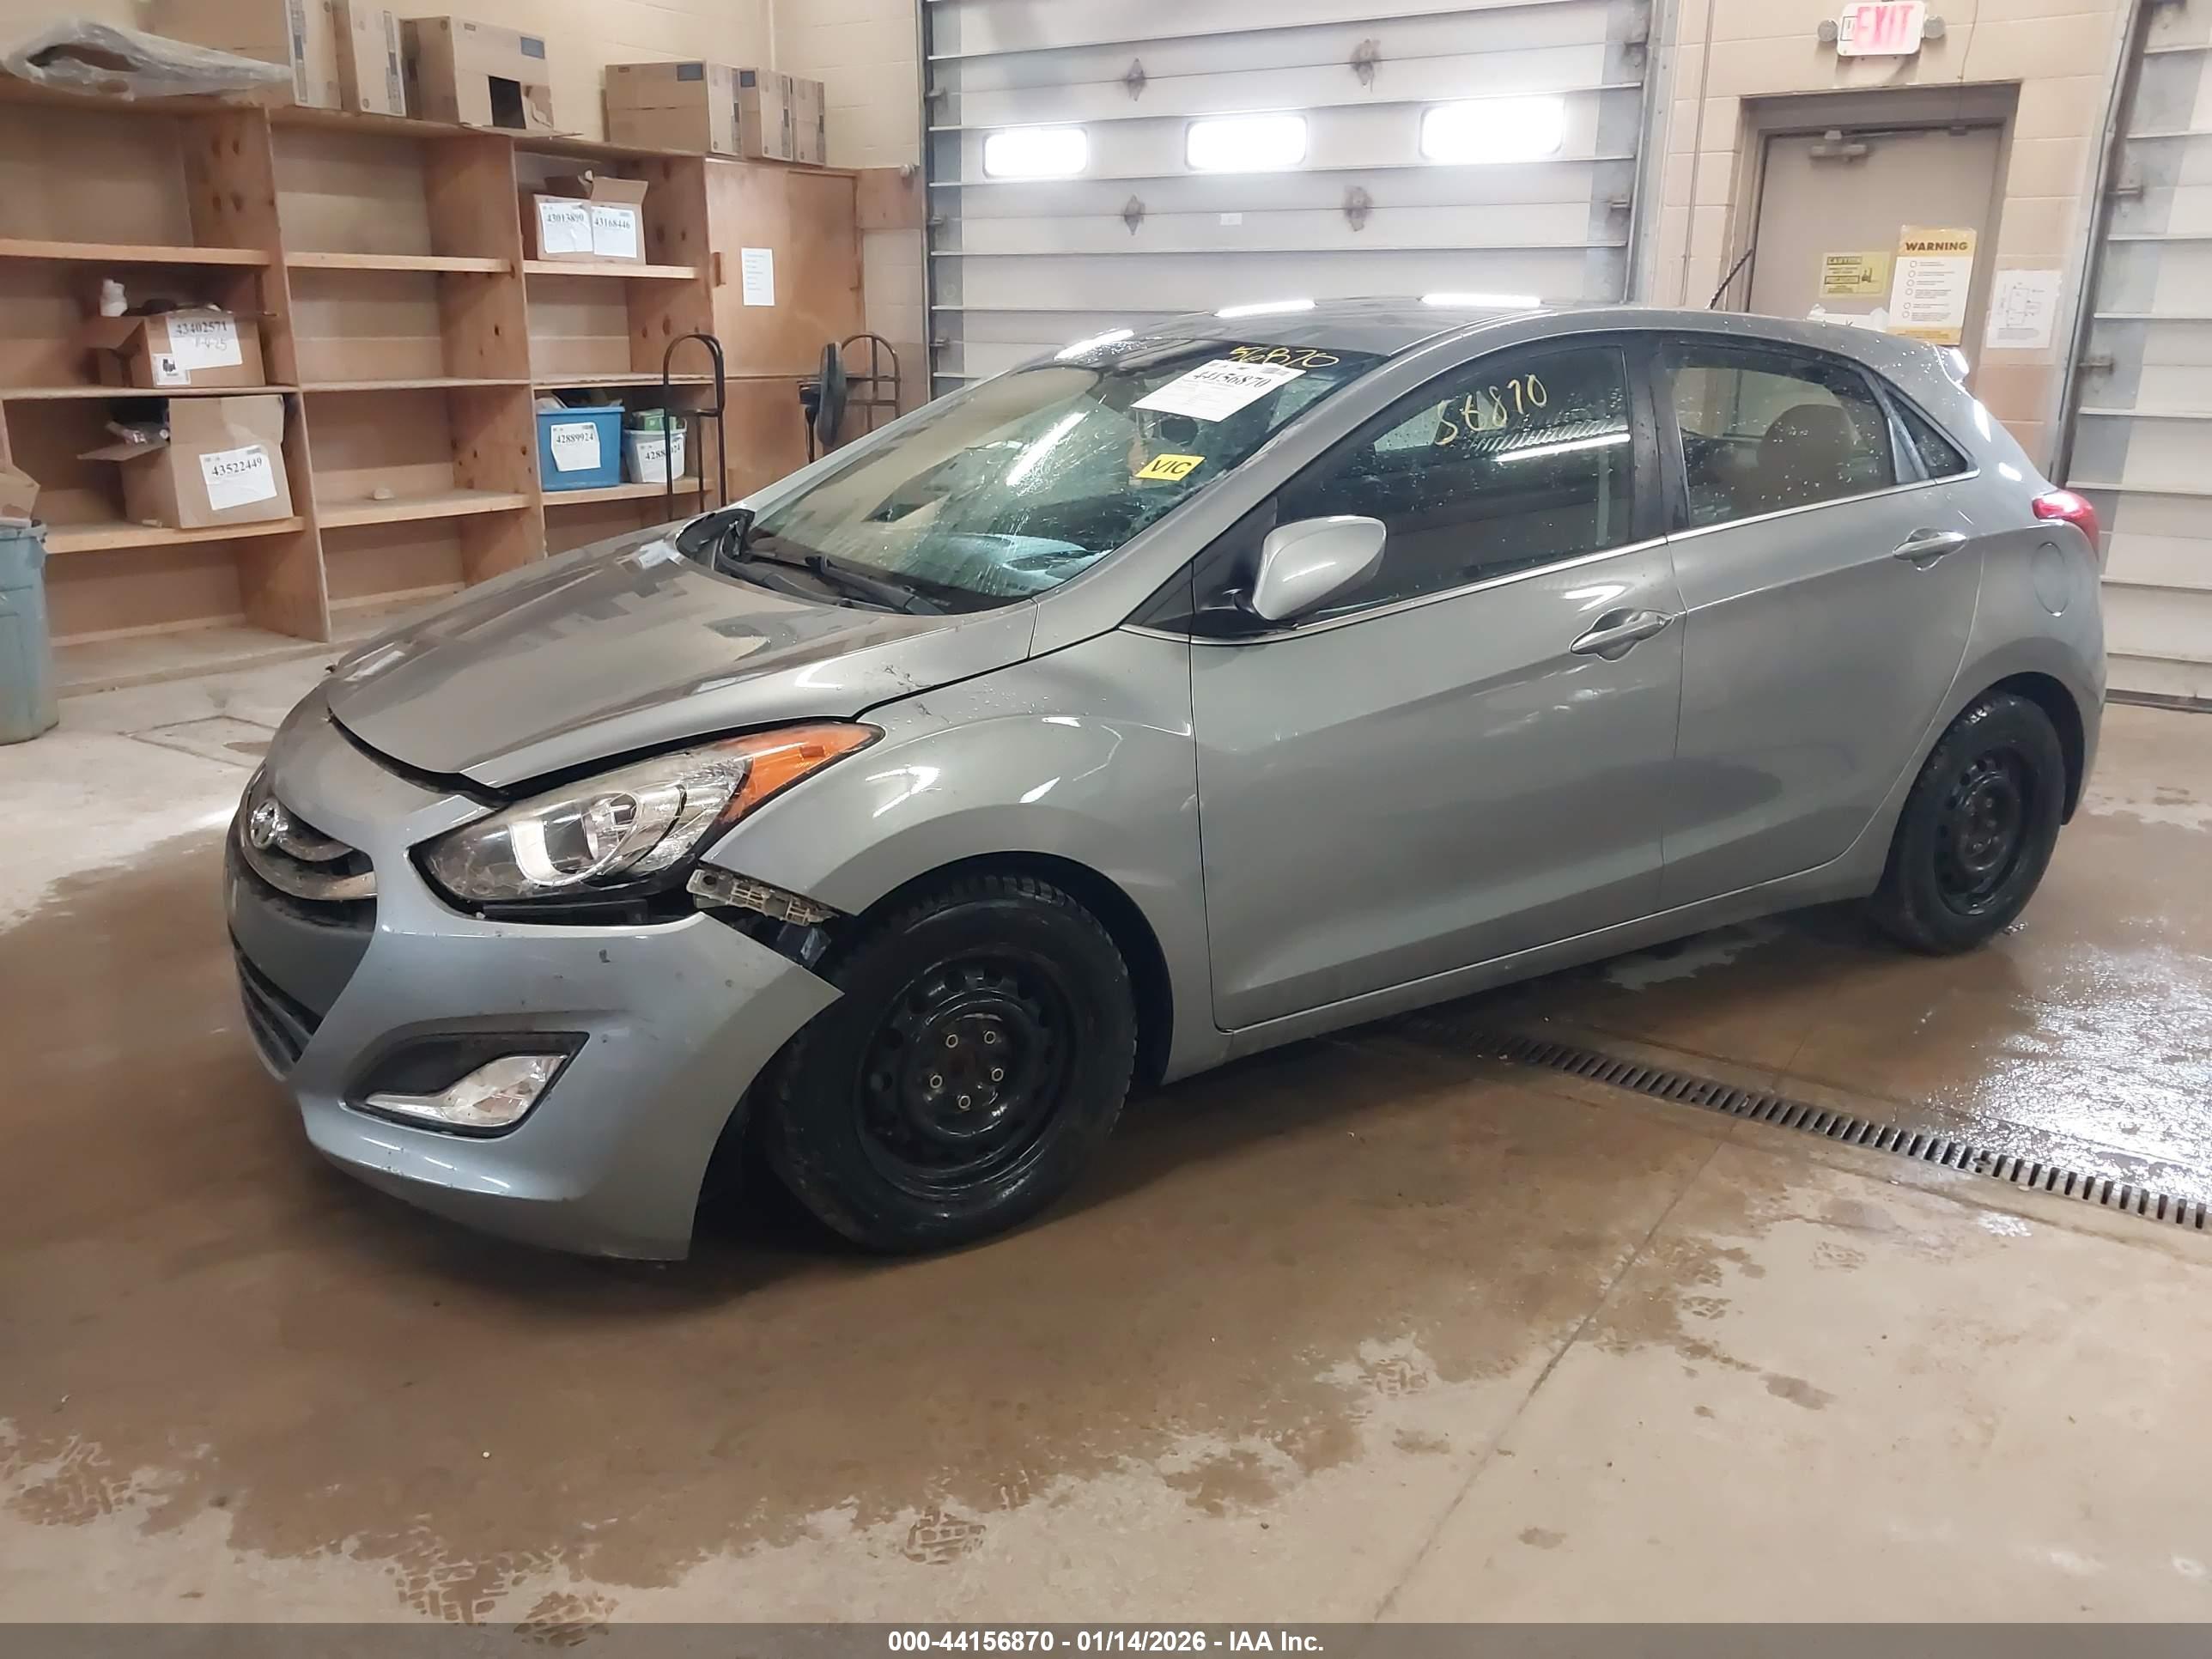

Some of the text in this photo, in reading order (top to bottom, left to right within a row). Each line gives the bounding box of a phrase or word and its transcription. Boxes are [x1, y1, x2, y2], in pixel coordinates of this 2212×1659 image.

[1855, 5, 1915, 47] EXIT
[594, 217, 630, 229] 43168446
[1905, 241, 1968, 251] WARNING
[1194, 371, 1272, 388] 44156870
[1435, 374, 1547, 446] 56870
[556, 433, 593, 444] 42889924
[212, 456, 262, 477] 43522449
[1152, 459, 1192, 474] VIC
